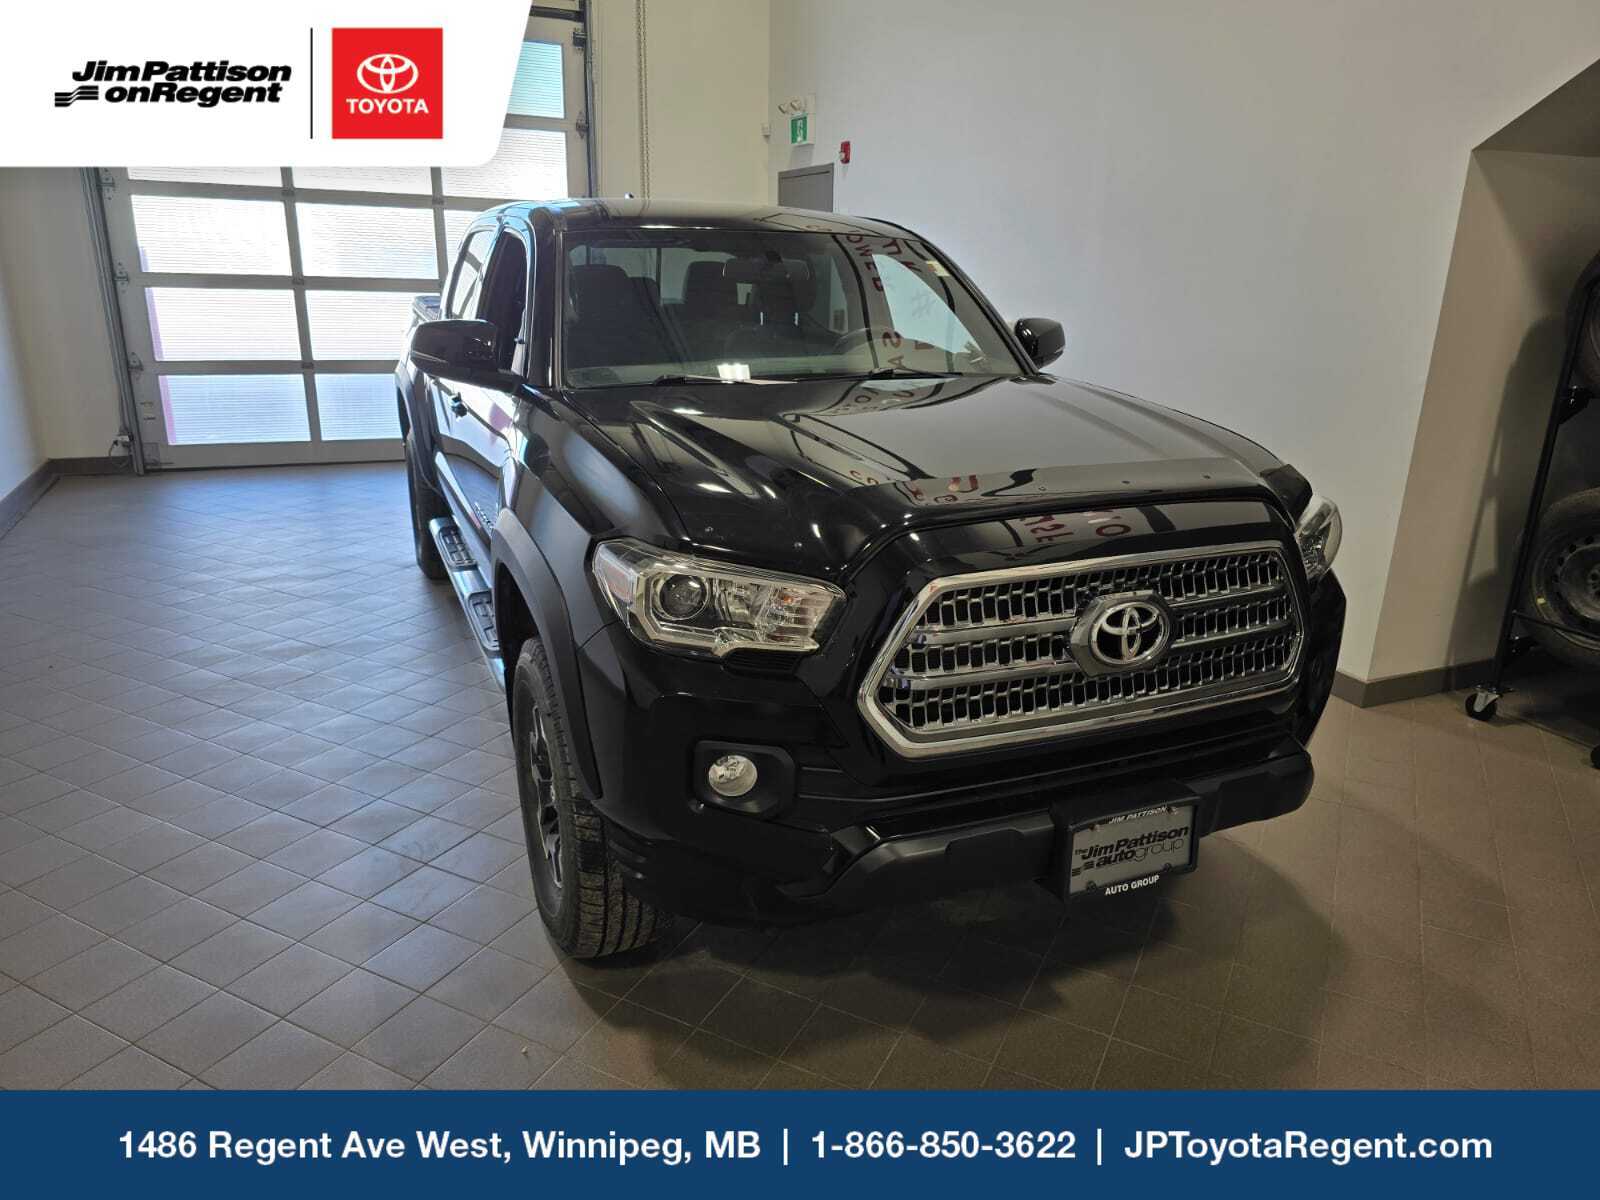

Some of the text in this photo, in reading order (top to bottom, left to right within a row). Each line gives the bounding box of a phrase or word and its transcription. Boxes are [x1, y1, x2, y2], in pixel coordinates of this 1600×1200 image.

[1109, 806, 1167, 825] JIM PATTISON
[1104, 874, 1160, 896] AUTO GROUP
